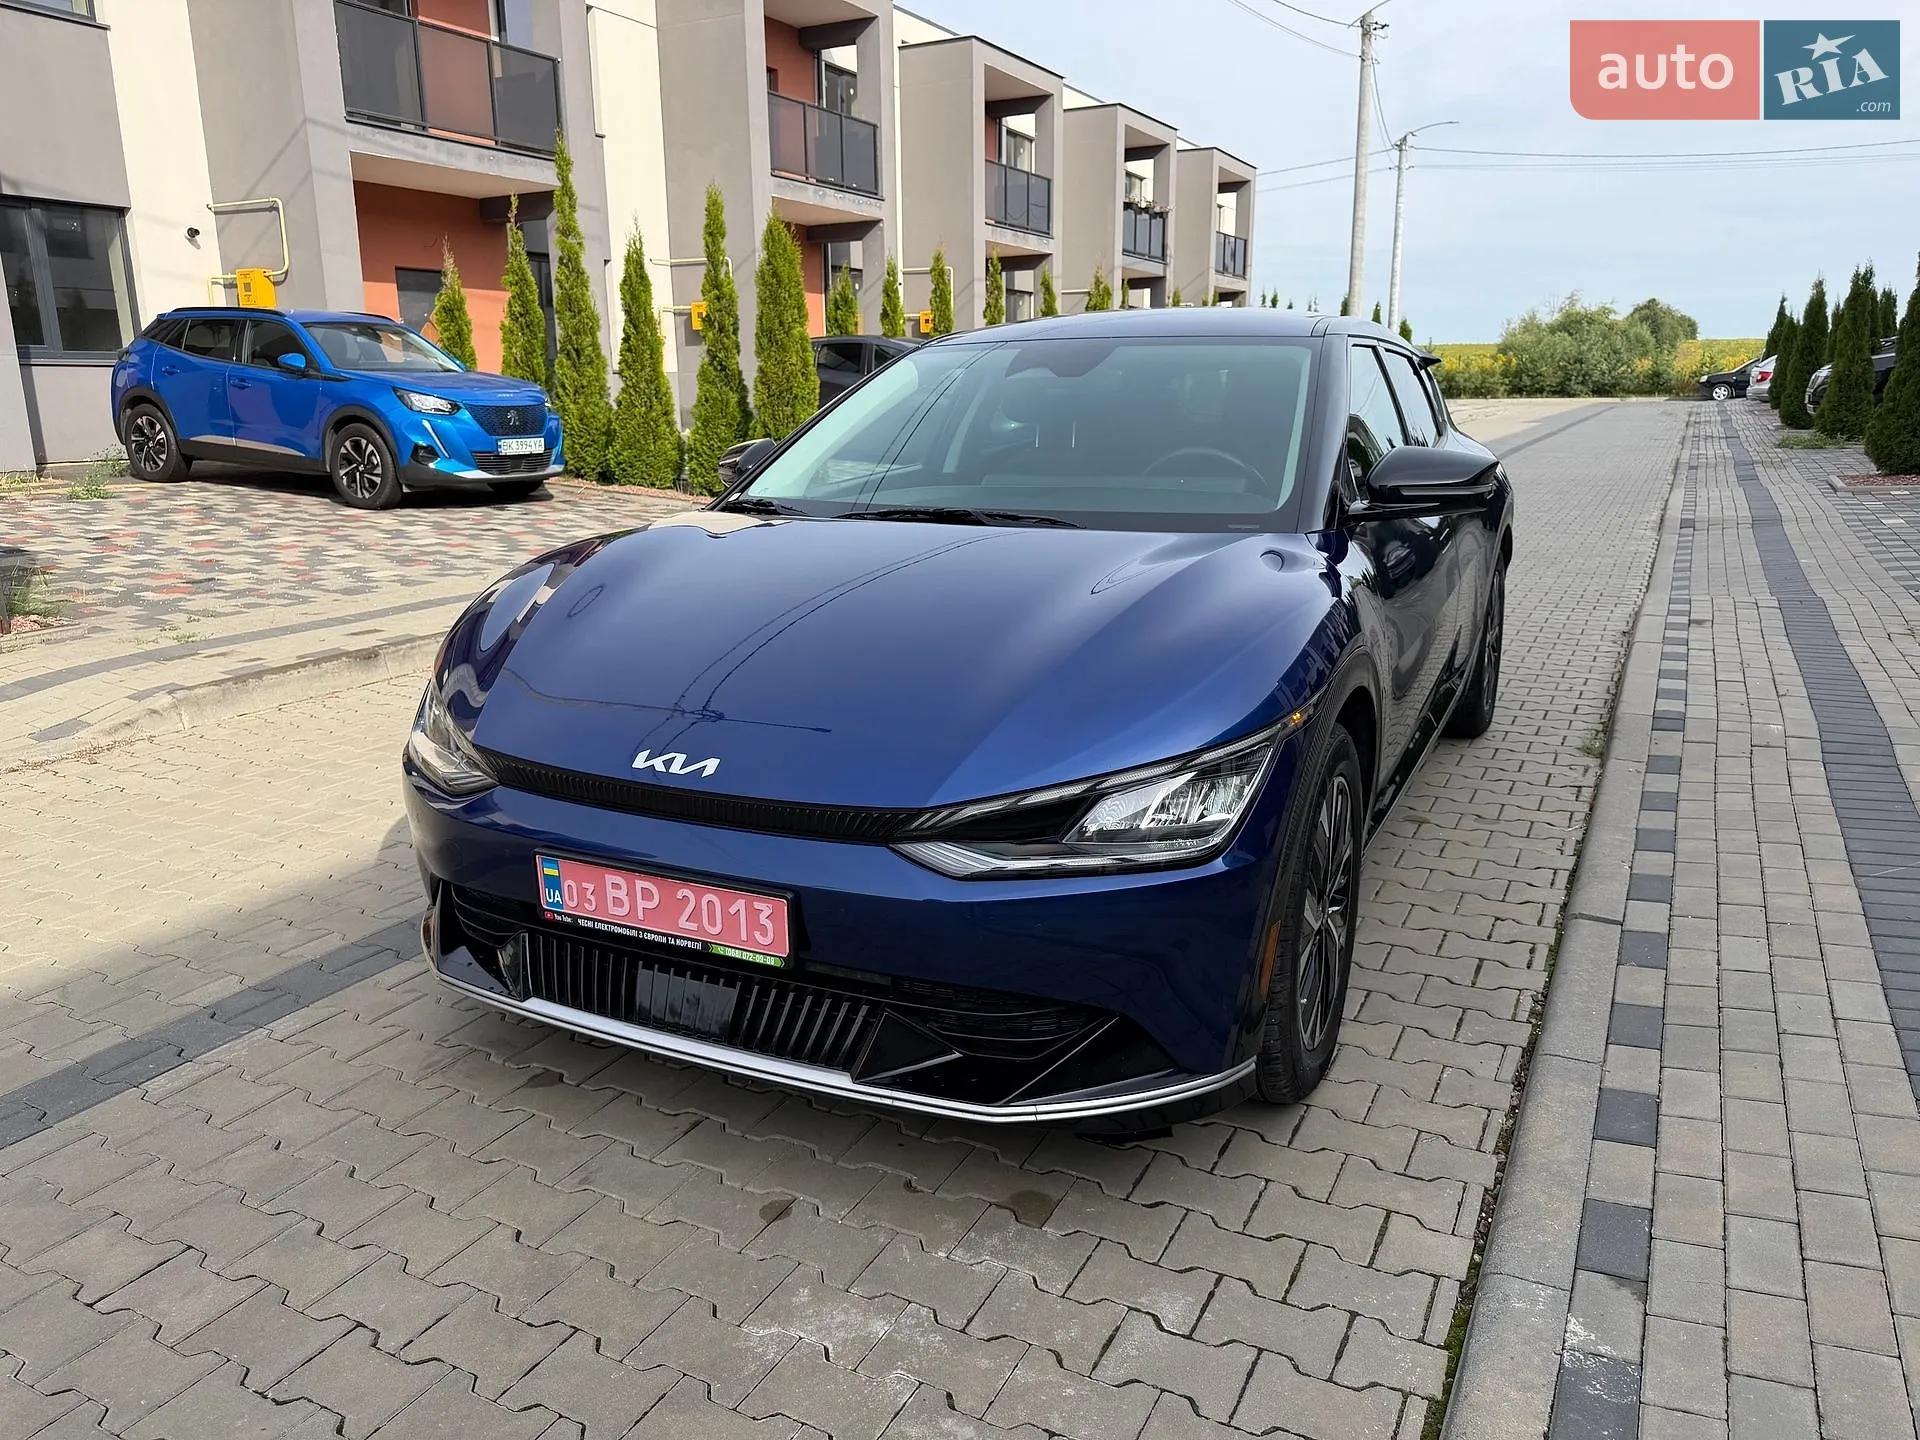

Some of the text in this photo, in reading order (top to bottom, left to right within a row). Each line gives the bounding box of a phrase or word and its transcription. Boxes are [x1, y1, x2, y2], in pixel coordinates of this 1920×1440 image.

[632, 749, 720, 777] KIA
[545, 888, 563, 904] UA
[563, 873, 774, 946] 03 BP 2013
[577, 919, 594, 928] ЧЕСНІ
[668, 937, 675, 945] ТА
